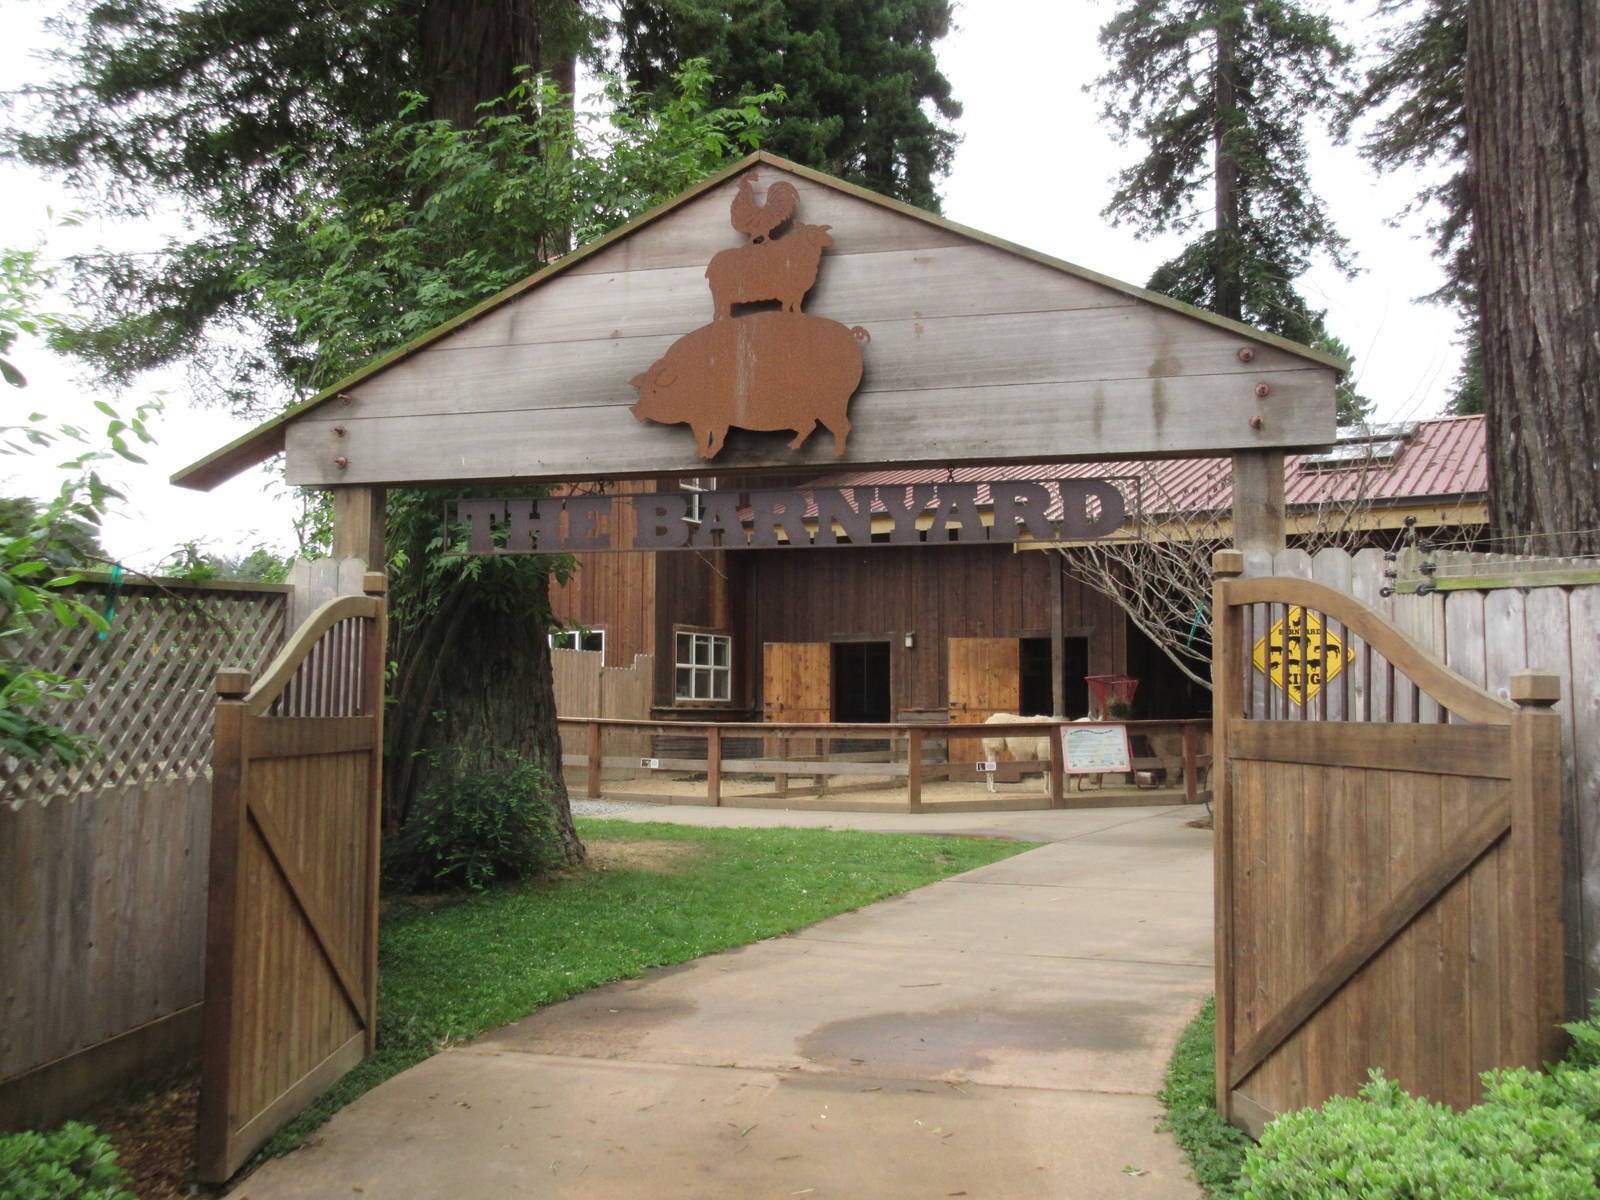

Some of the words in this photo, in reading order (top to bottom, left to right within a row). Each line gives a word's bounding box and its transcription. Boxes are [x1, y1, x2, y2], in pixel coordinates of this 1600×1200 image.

[456, 499, 614, 552] THE
[634, 481, 1125, 549] BARNYARD
[1278, 628, 1321, 636] BRNARD
